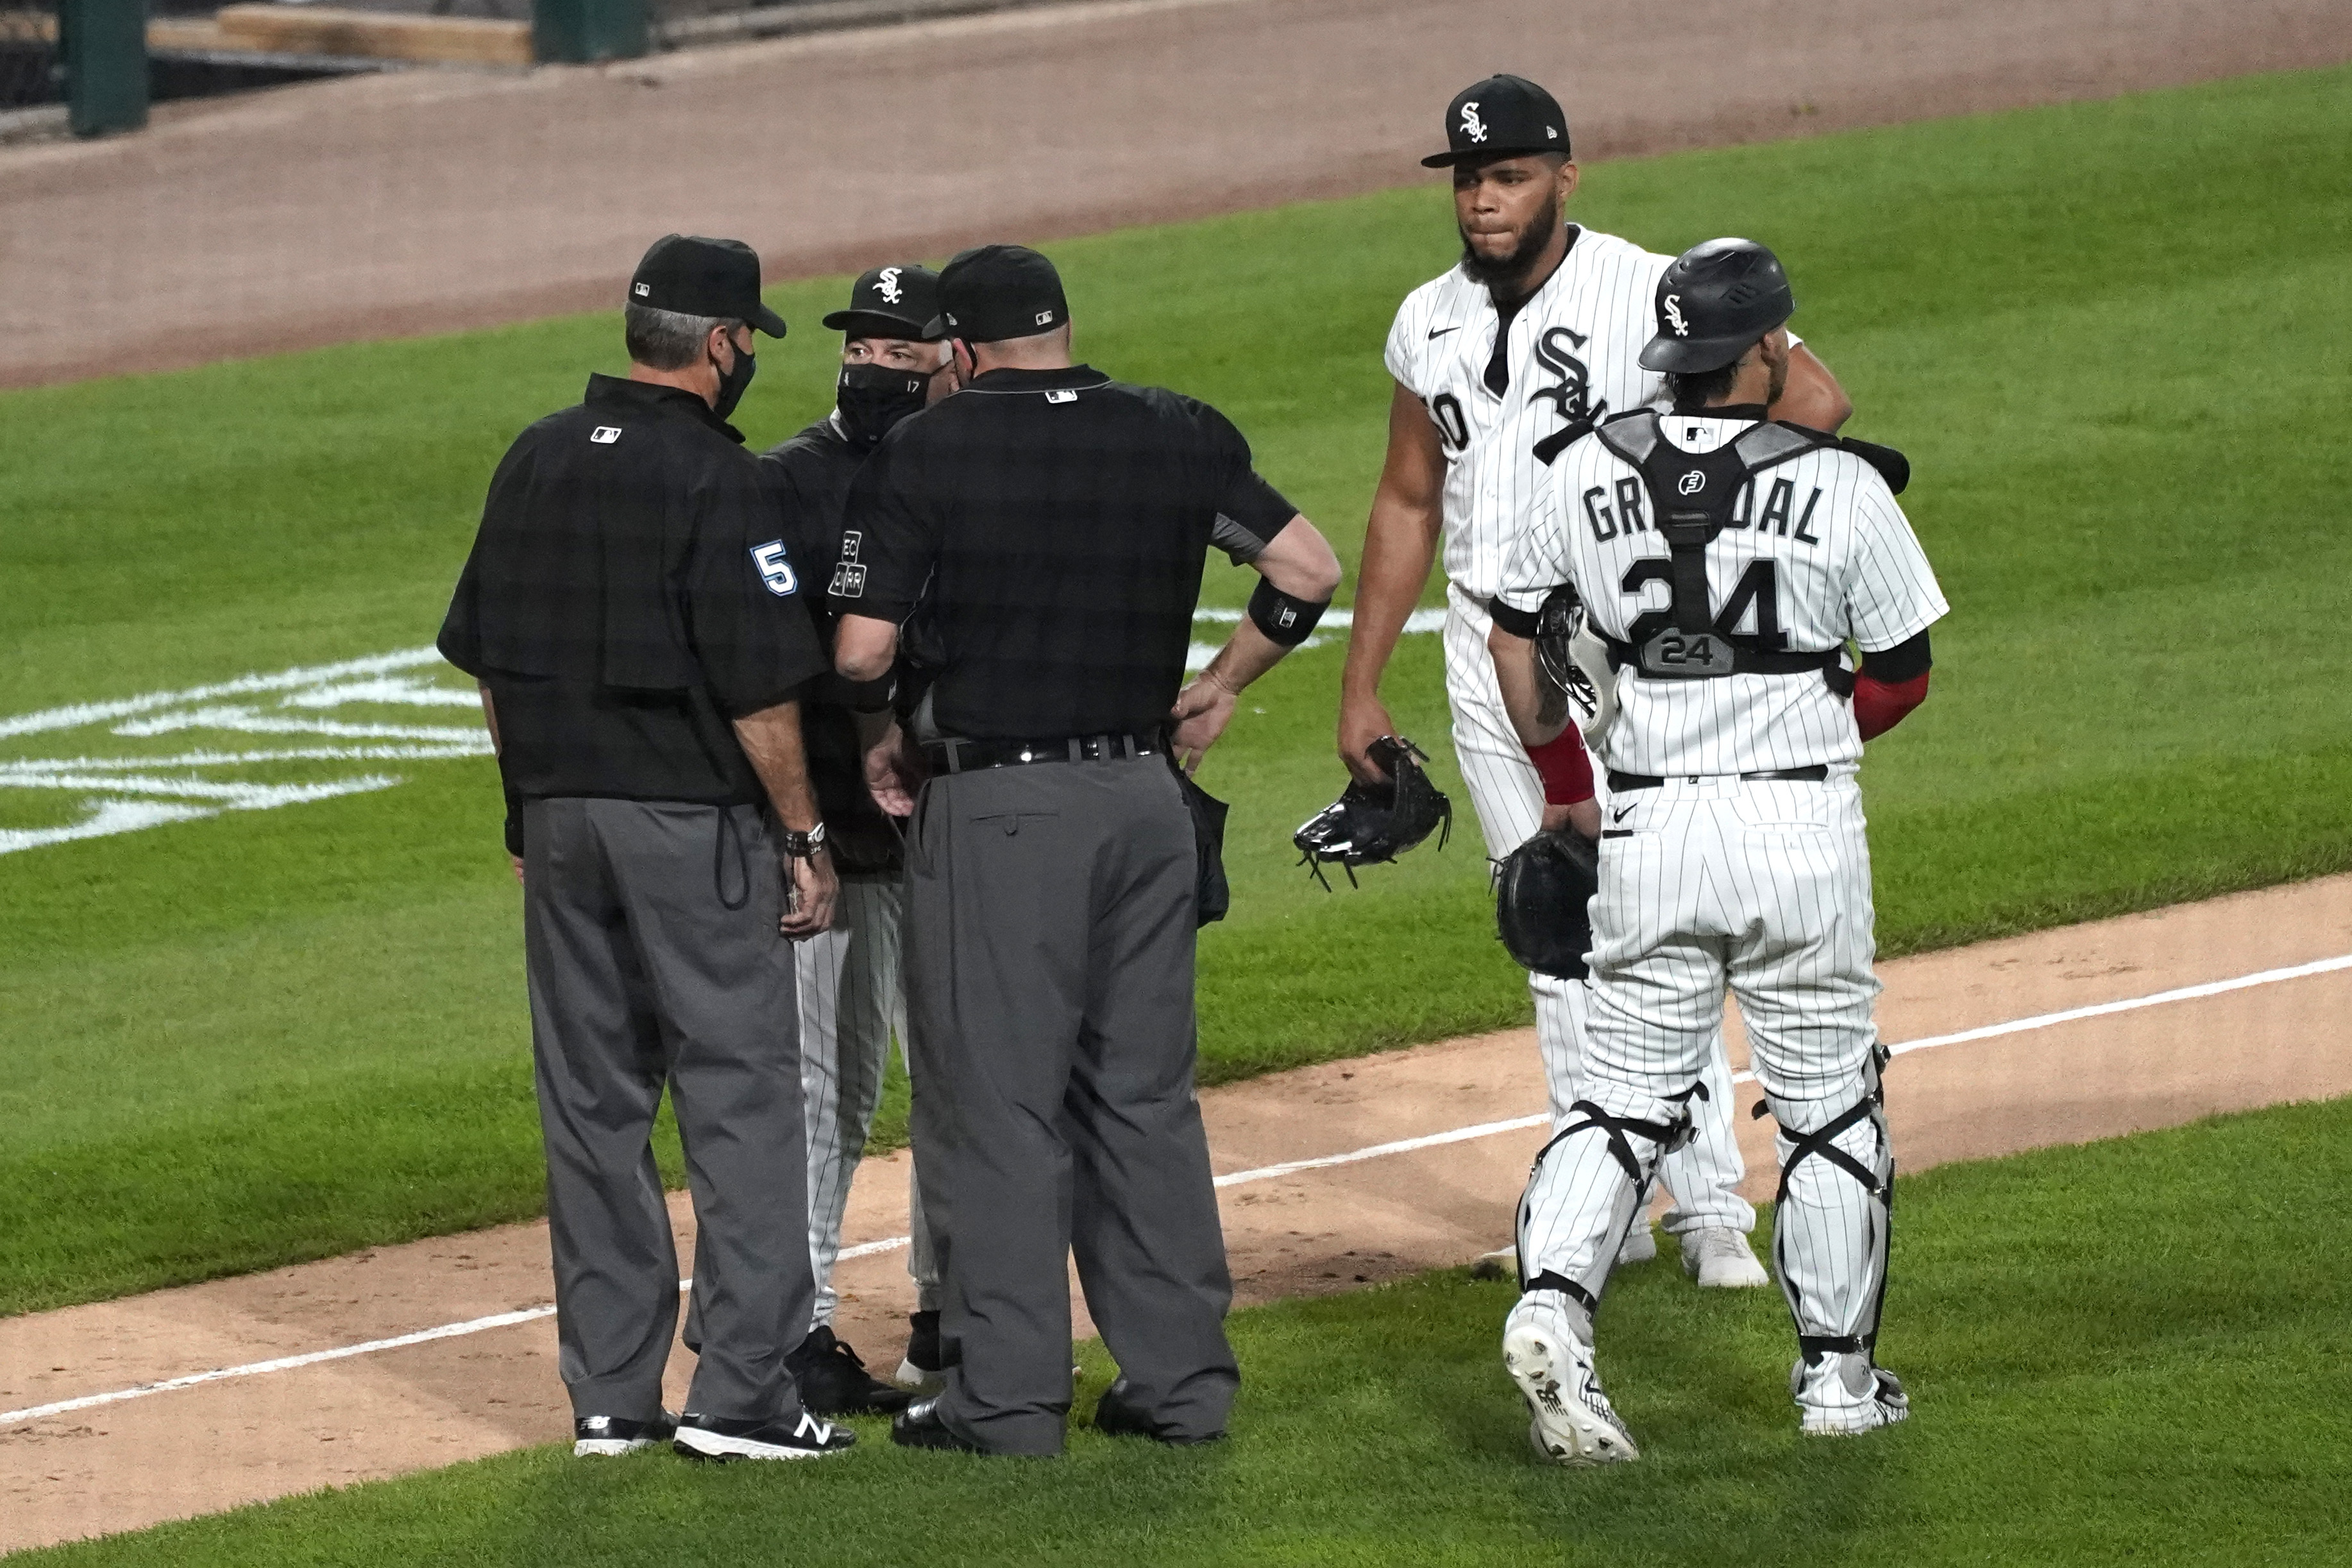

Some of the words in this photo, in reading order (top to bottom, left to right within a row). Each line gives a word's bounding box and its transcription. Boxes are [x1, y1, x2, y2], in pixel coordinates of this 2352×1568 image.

[906, 380, 920, 393] 17
[843, 539, 857, 556] EC
[749, 538, 798, 597] 5
[1661, 636, 1714, 667] 24
